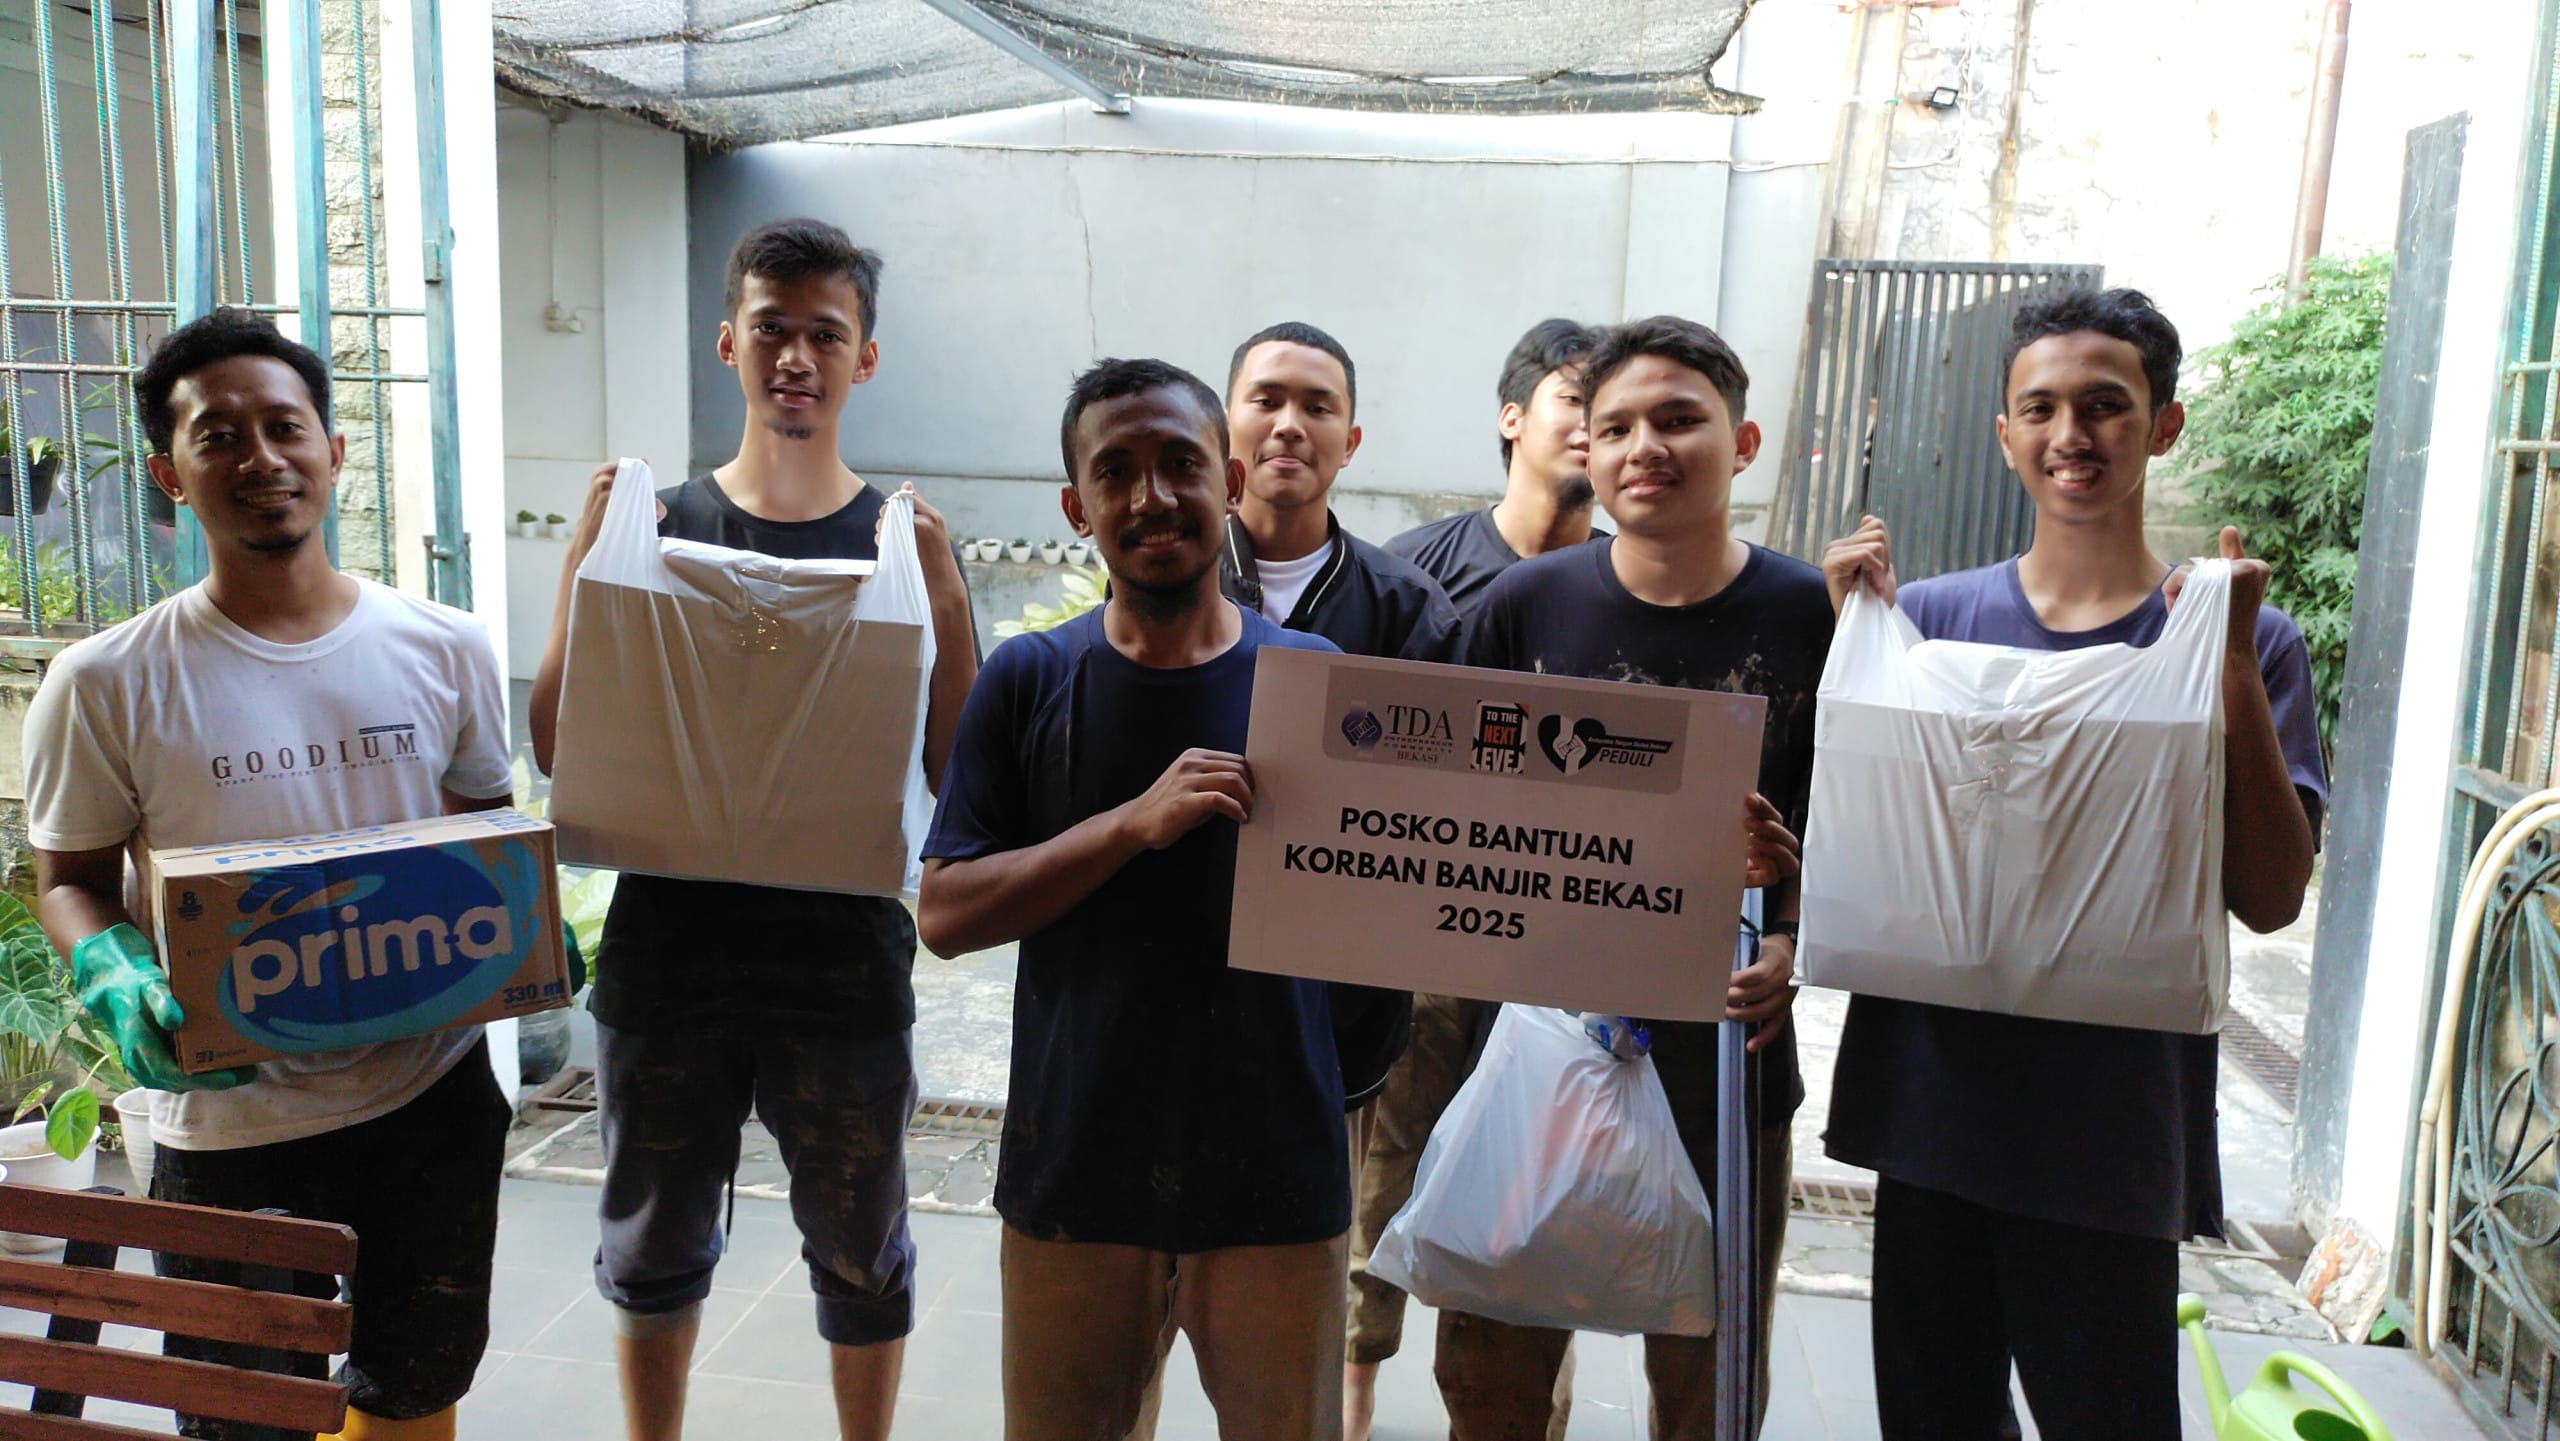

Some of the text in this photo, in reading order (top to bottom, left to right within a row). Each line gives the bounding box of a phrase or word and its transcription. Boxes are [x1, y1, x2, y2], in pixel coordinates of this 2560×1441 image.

[1387, 705, 1453, 740] TDA
[1486, 711, 1519, 723] TO THE
[1483, 724, 1518, 746] NEXT
[212, 732, 417, 779] GOODIUM
[1397, 751, 1438, 763] BEKASI
[1599, 749, 1655, 767] PEDULI
[216, 836, 417, 865] prima
[1339, 807, 1634, 865] POSKO BANTUAN
[1284, 844, 1683, 914] KORBAN BANJIR BEKASI
[1436, 903, 1526, 940] 2025
[231, 904, 513, 1014] prima
[504, 983, 537, 1004] 330
